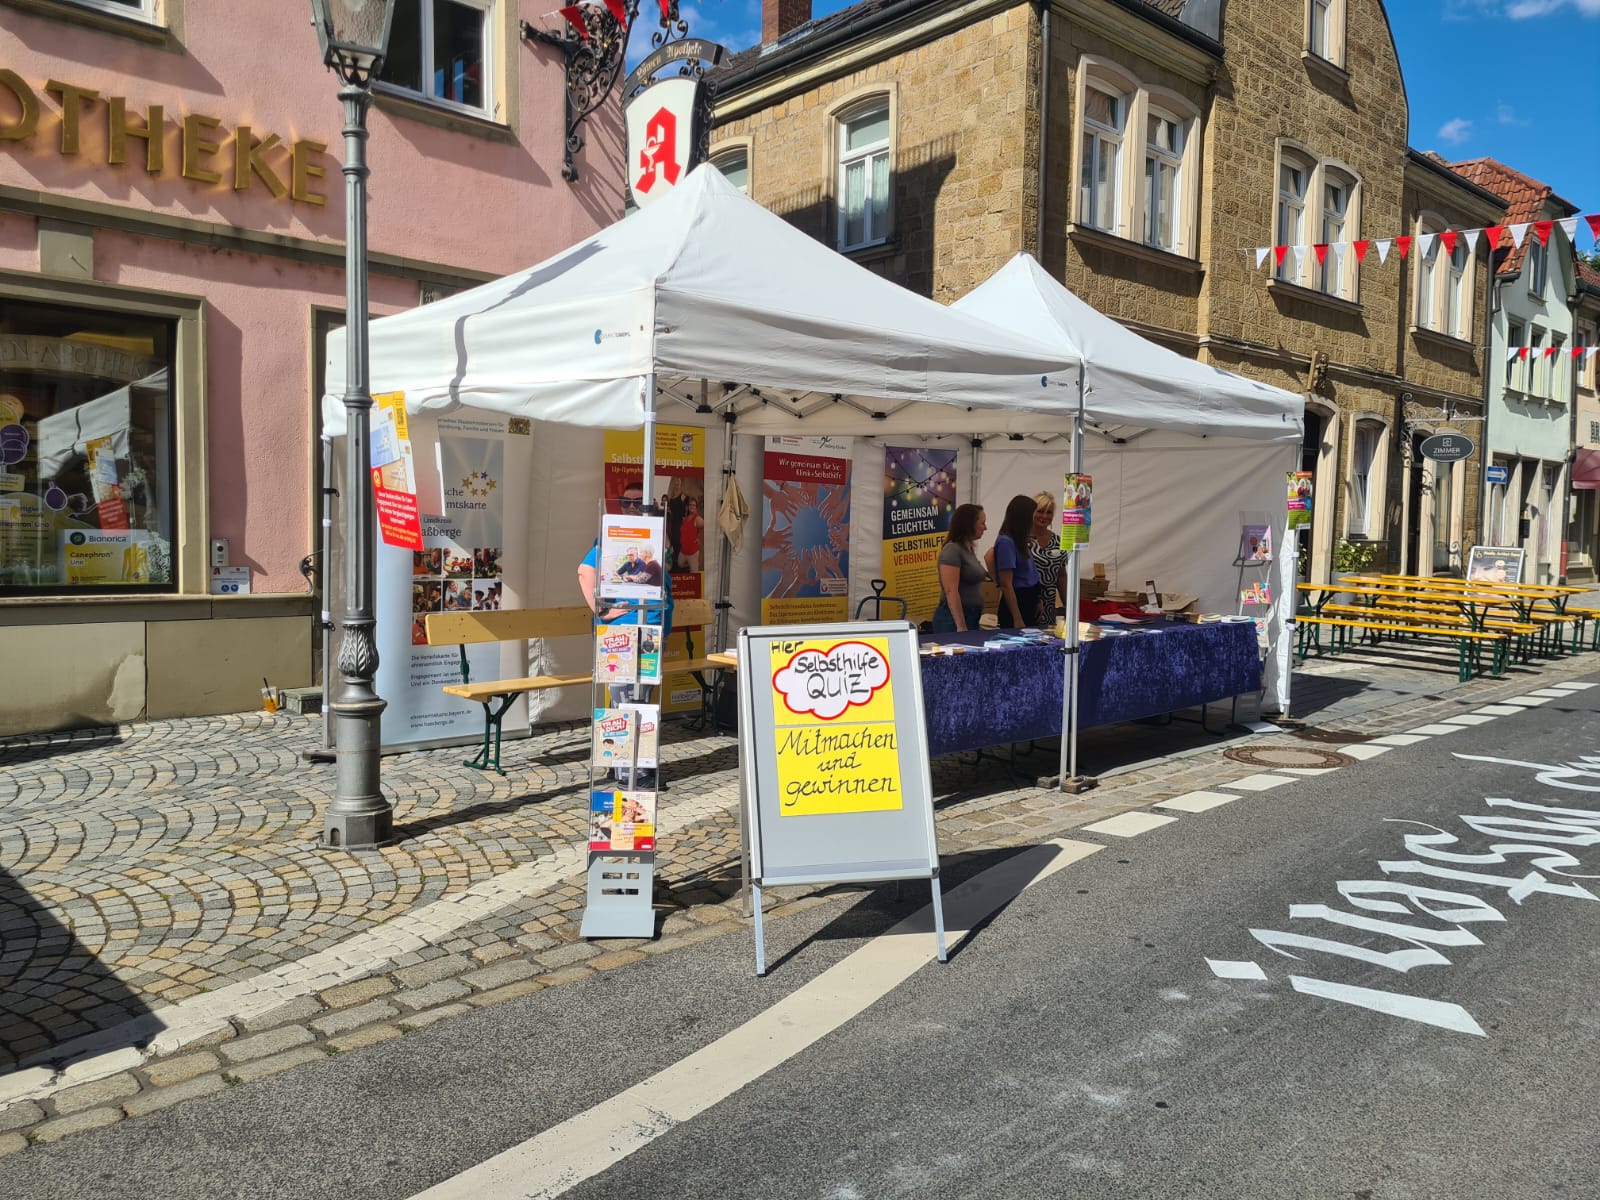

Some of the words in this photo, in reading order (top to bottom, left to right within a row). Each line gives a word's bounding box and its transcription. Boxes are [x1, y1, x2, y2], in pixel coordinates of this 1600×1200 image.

[666, 42, 703, 58] Apotheke
[790, 460, 822, 470] gemeinsam
[891, 505, 939, 522] GEMEINSAM
[891, 519, 936, 536] LEUCHTEN.
[893, 550, 938, 566] VERBINDET
[794, 652, 879, 675] Selbsthilfe
[778, 727, 897, 756] Mitmachen
[817, 752, 863, 772] und
[785, 774, 897, 807] gewinnen
